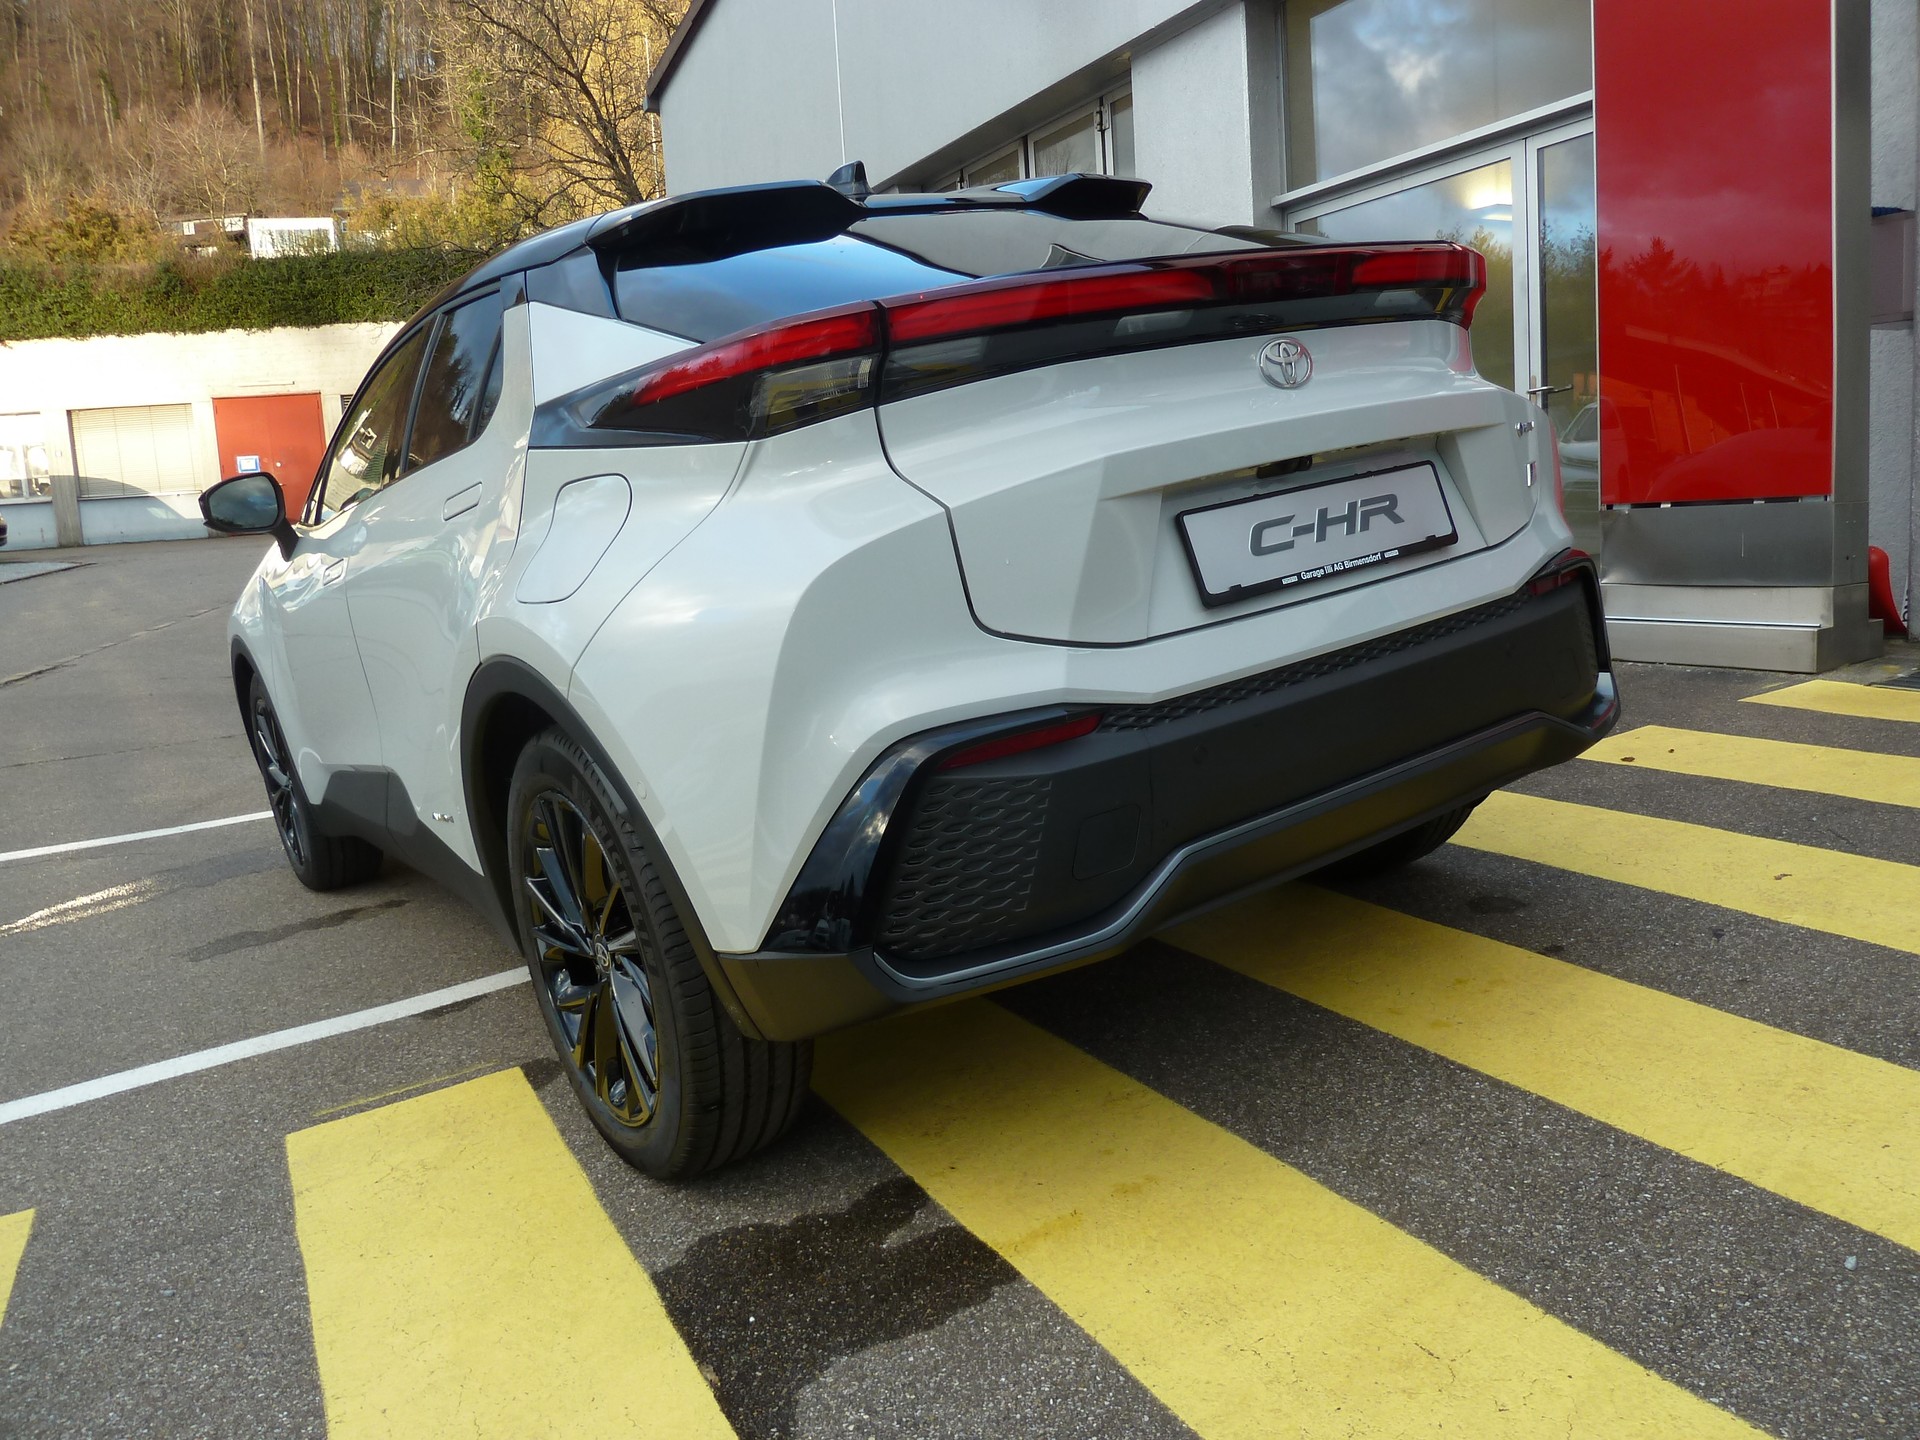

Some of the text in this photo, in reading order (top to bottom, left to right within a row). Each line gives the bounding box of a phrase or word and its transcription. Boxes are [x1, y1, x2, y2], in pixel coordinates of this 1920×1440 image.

[1249, 493, 1405, 557] C-HR
[1300, 569, 1325, 580] Garage
[1333, 562, 1344, 572] AG
[1343, 552, 1382, 569] Birmensdorf
[593, 814, 658, 970] MICHELIN
